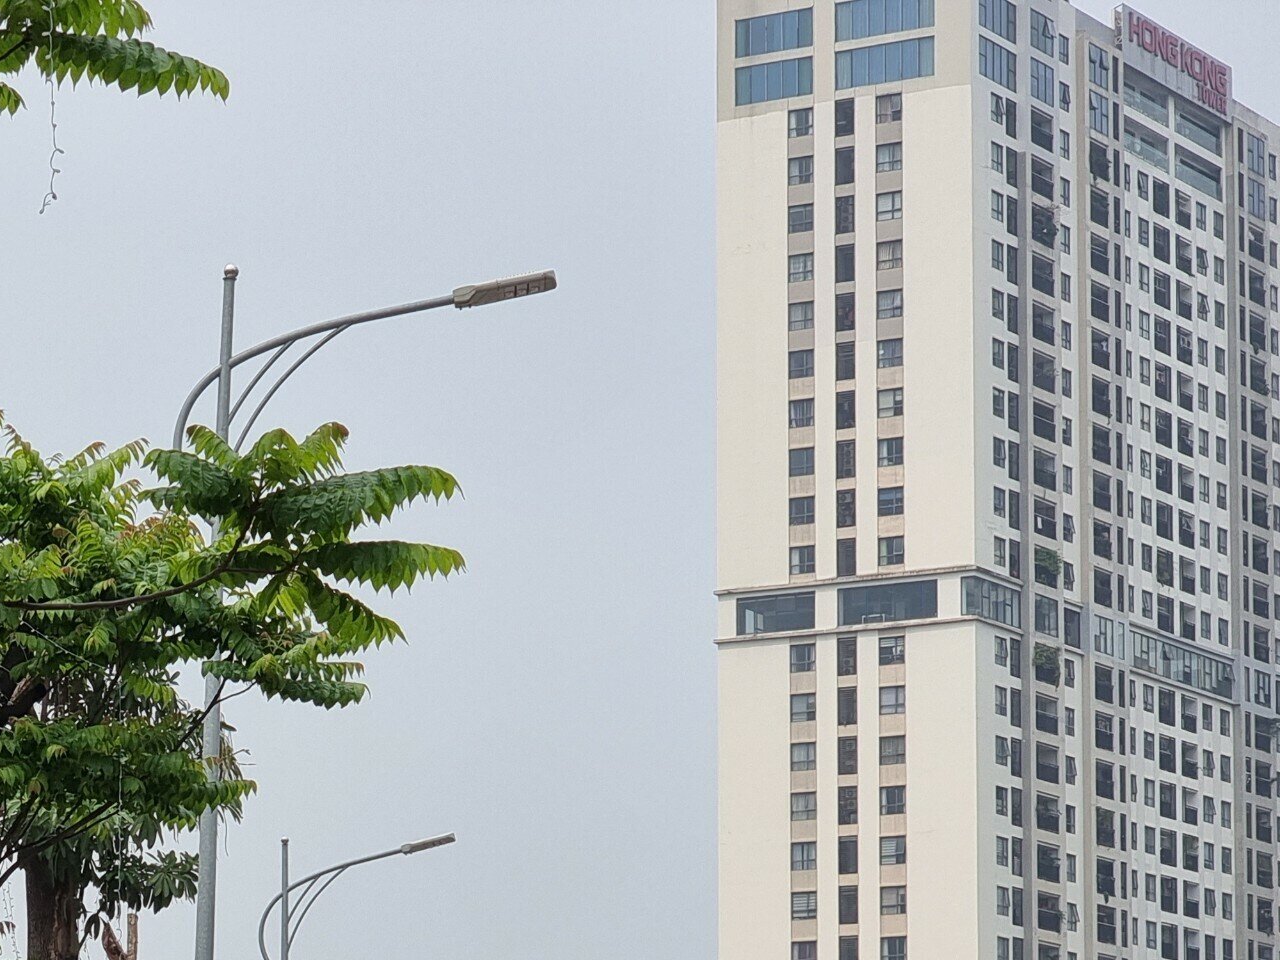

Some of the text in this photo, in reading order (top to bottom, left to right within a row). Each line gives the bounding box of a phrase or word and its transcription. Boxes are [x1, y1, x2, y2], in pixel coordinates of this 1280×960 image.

[1128, 11, 1227, 97] HONG KONG
[1196, 82, 1227, 116] TOWER
